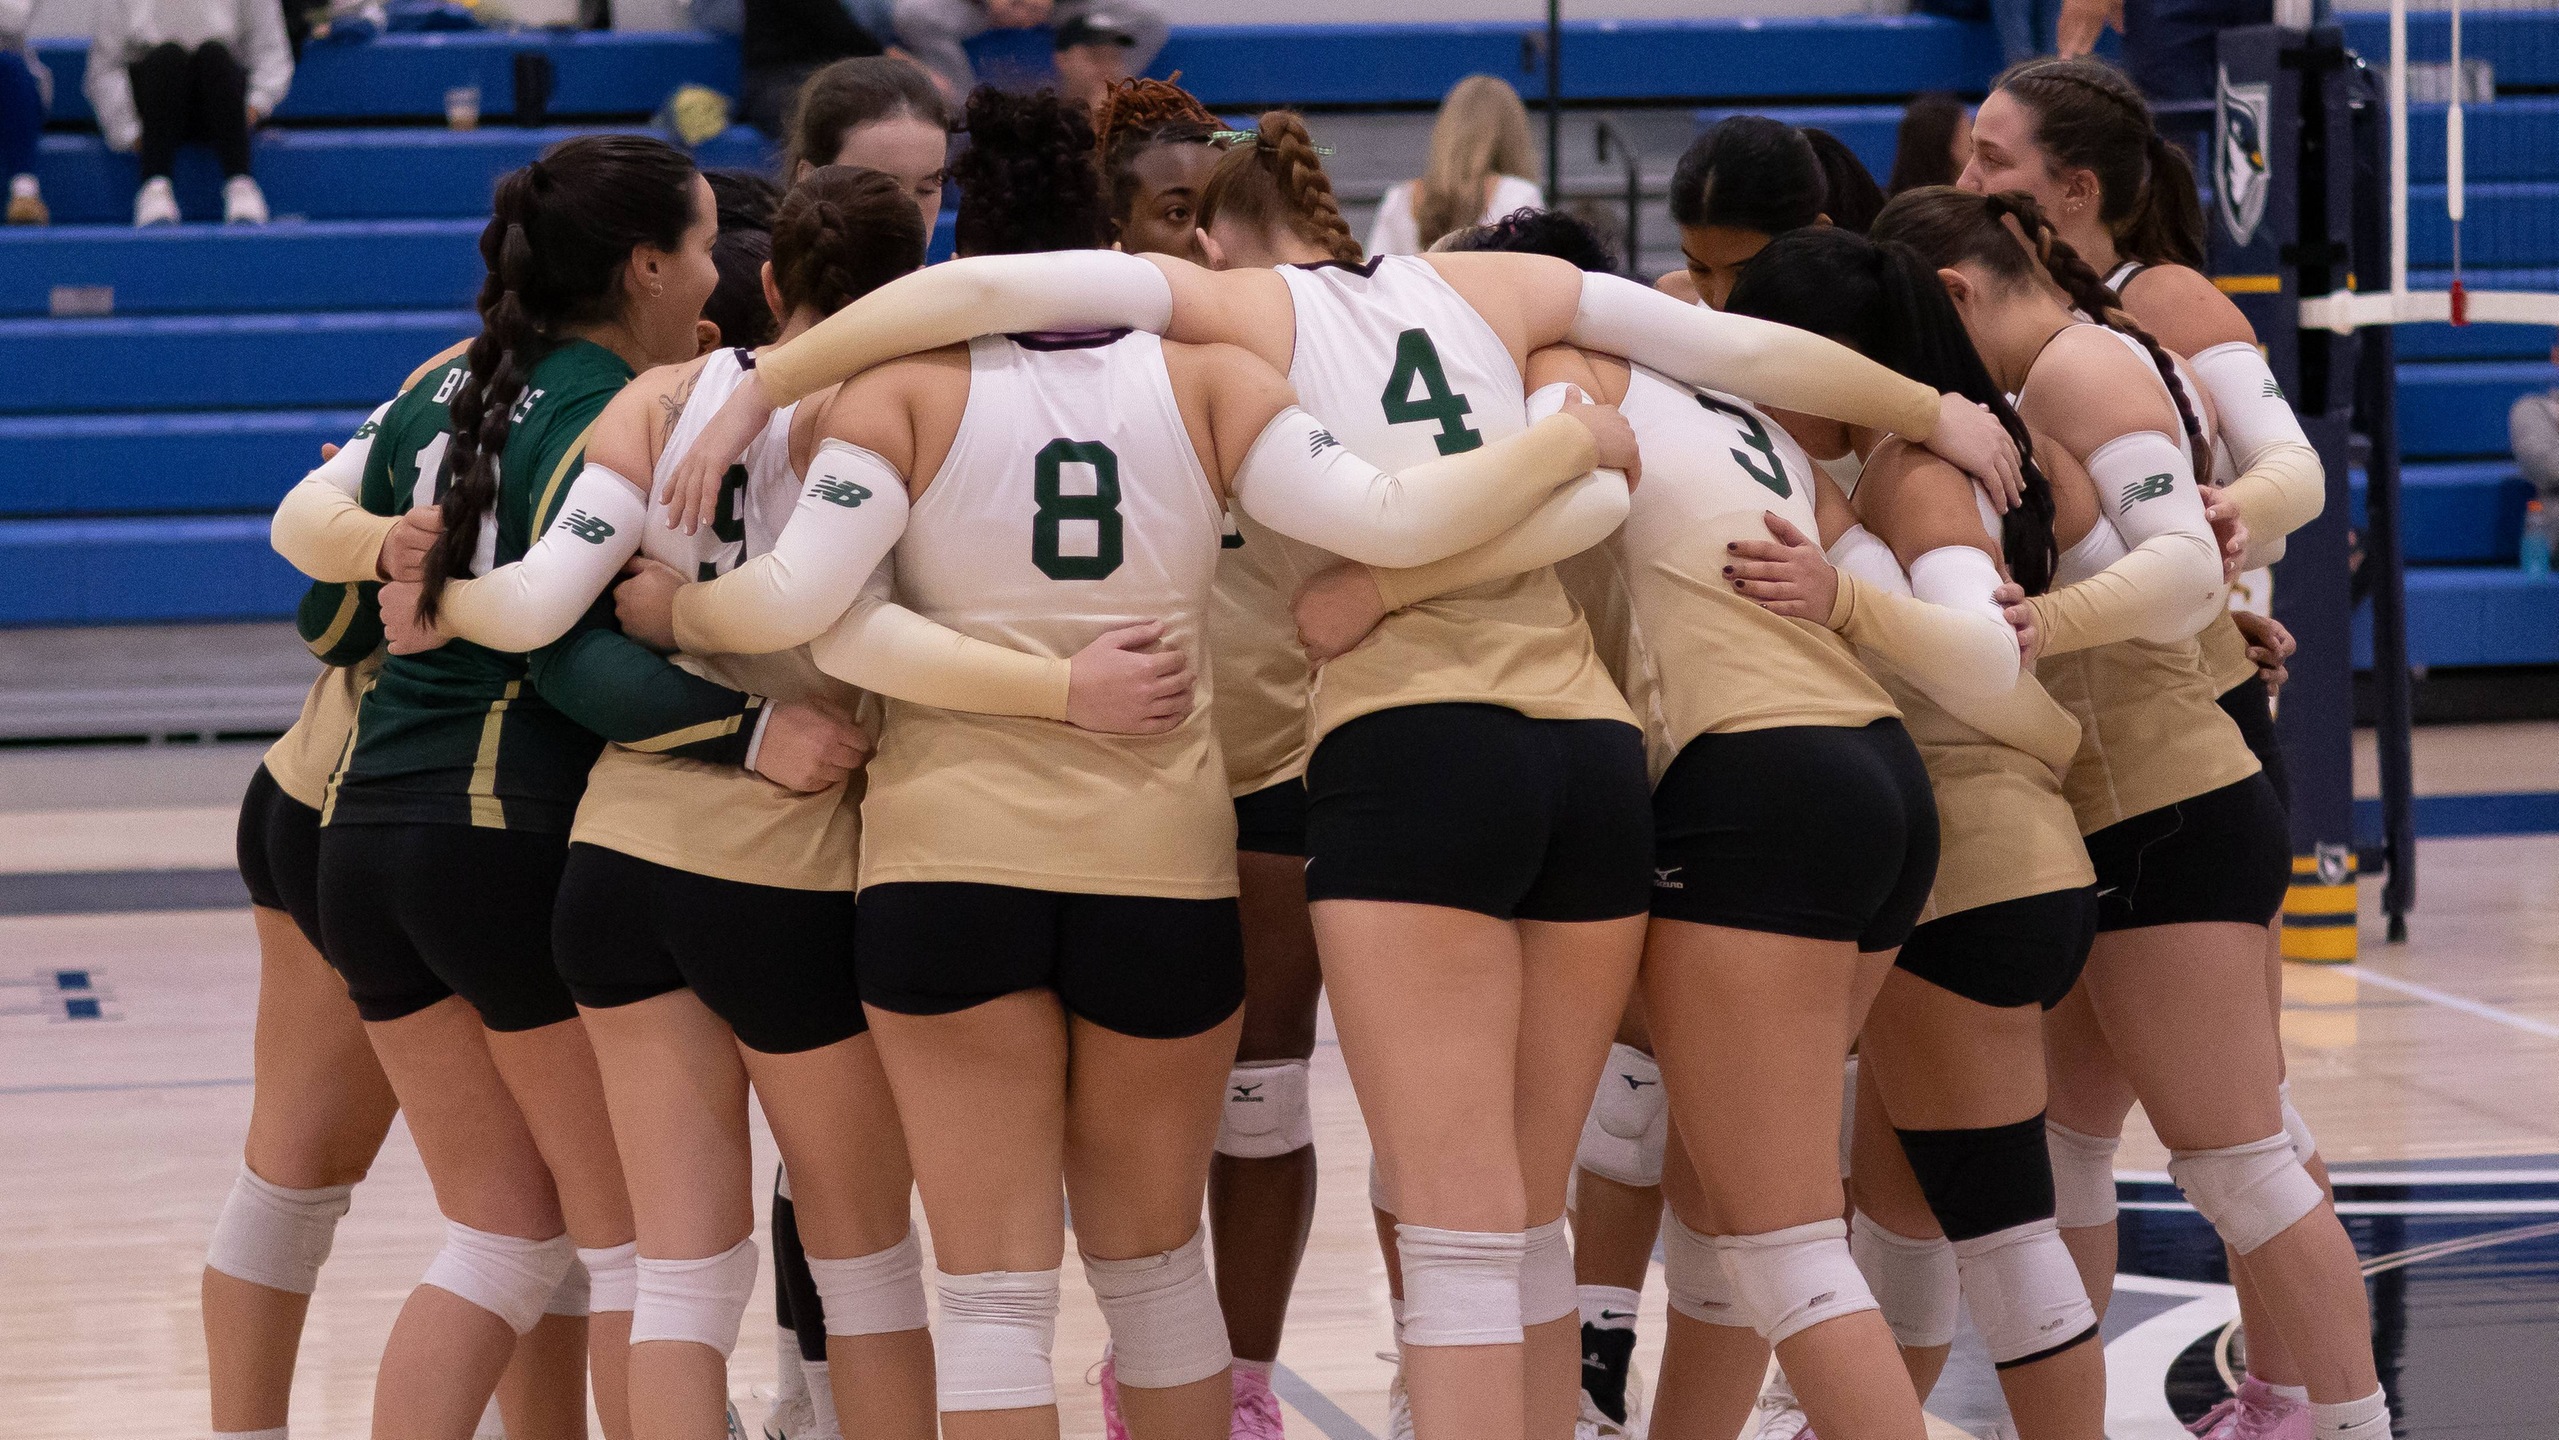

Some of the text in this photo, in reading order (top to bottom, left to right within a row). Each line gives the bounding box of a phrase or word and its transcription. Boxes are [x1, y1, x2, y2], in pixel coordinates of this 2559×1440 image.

[1381, 327, 1484, 456] 4
[1694, 393, 1793, 500] 3
[558, 508, 616, 544] NB
[806, 474, 873, 508] NB
[1032, 438, 1124, 580] 8
[2120, 473, 2175, 516] NB
